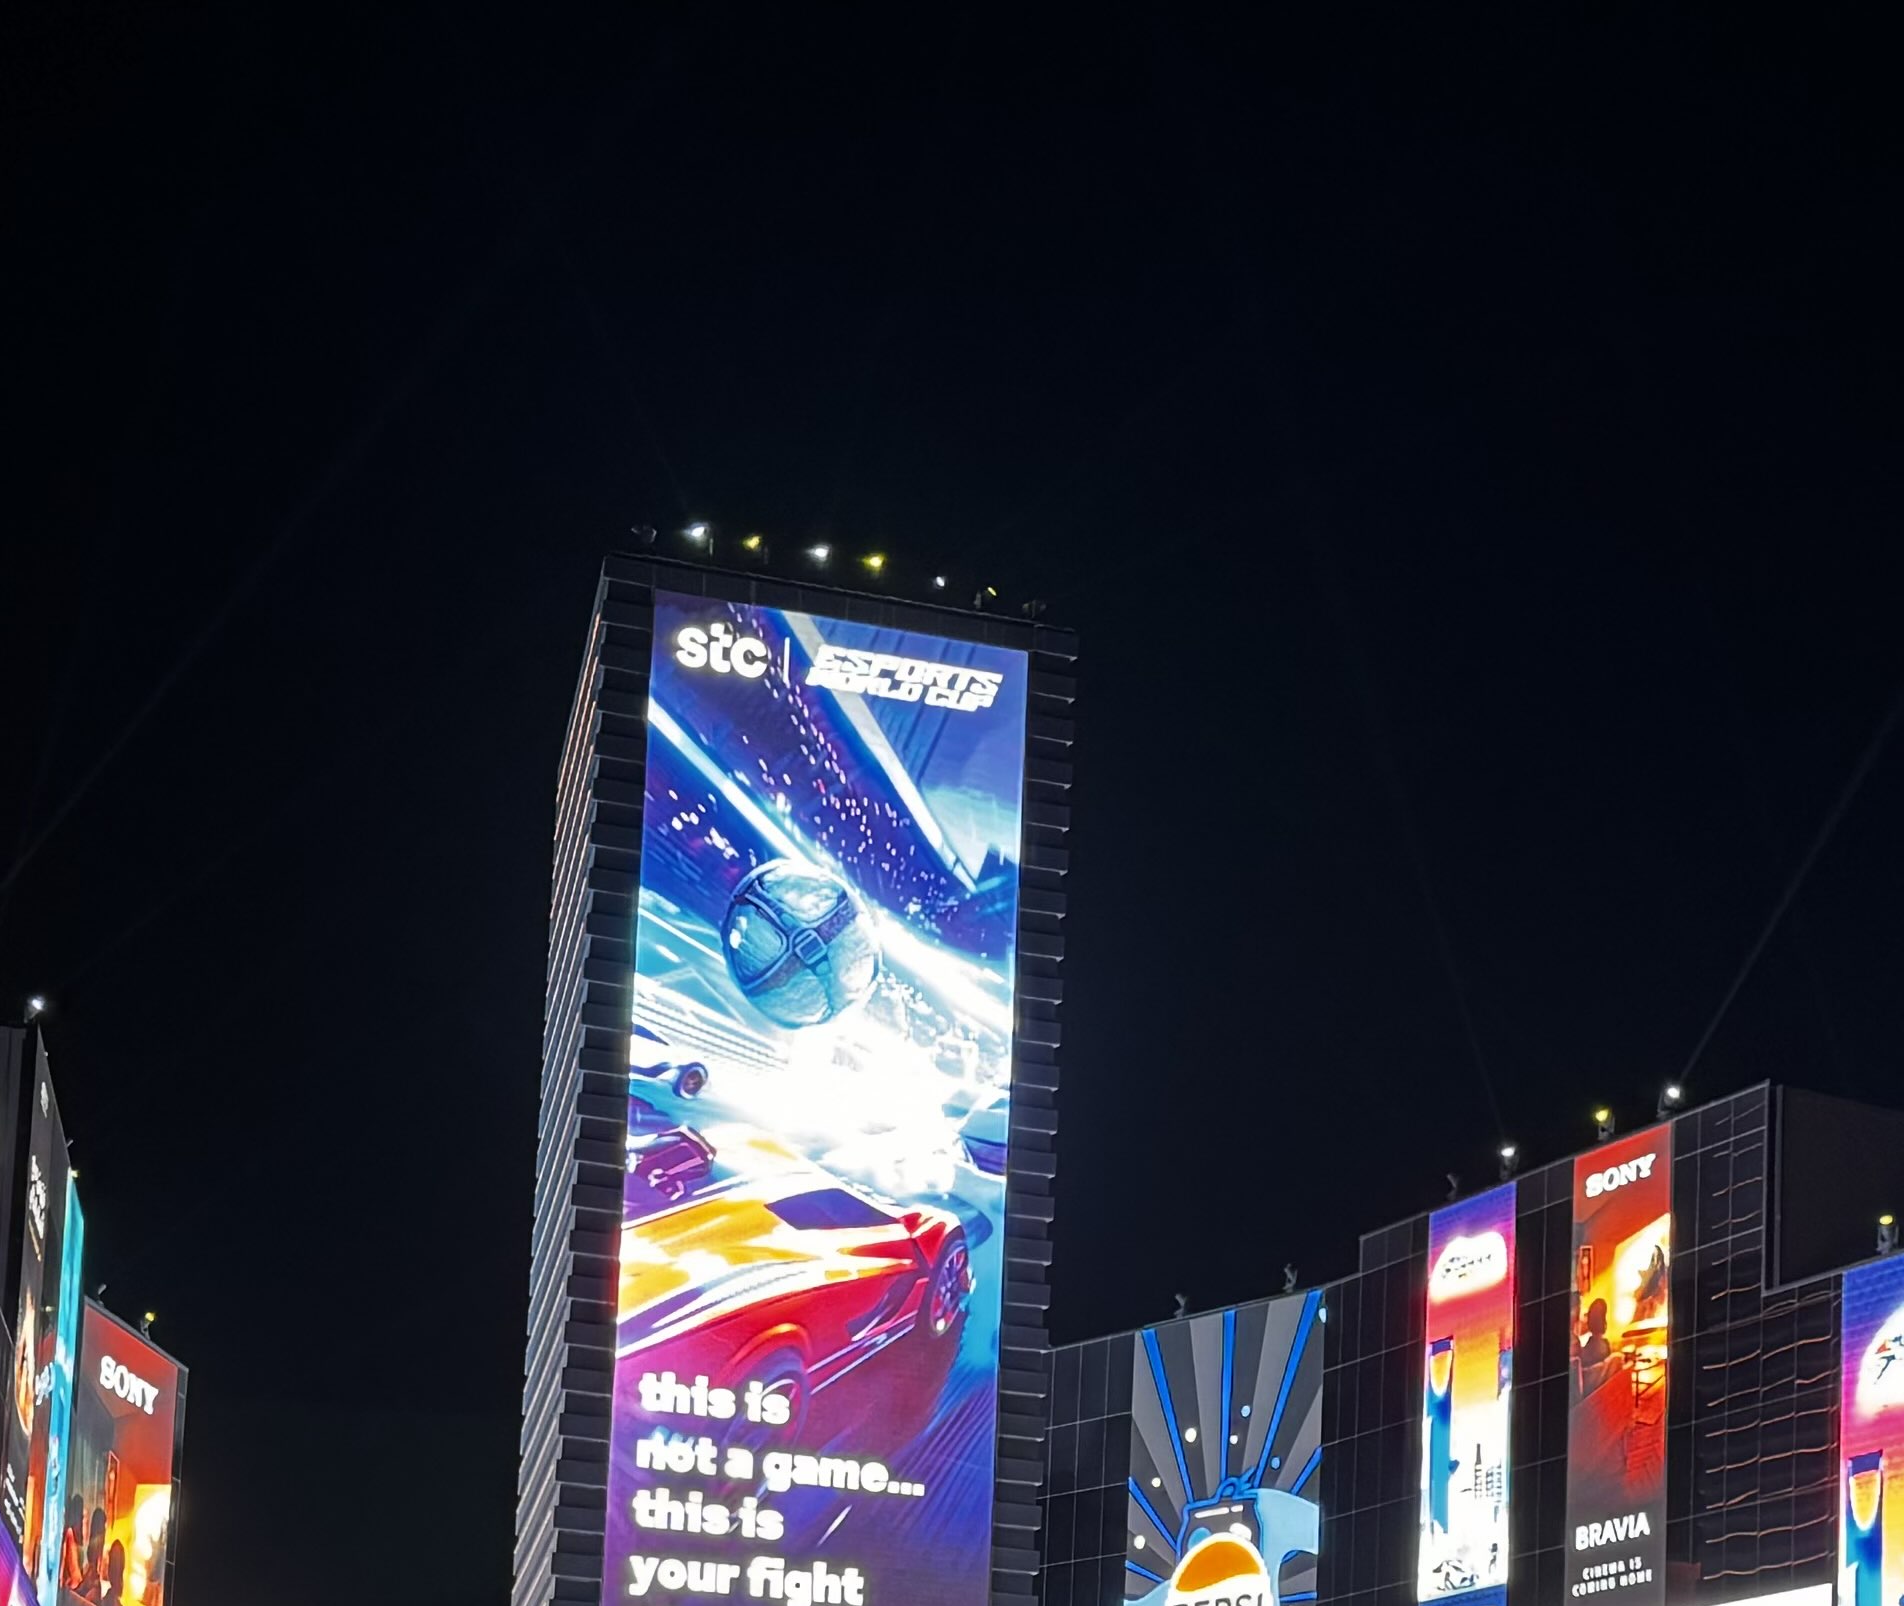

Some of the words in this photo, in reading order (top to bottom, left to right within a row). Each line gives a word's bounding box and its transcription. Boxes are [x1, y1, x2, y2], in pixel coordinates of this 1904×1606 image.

[675, 622, 769, 678] stc
[814, 644, 1003, 693] ESPORTS
[806, 669, 921, 703] WORLD
[925, 684, 995, 712] CUP
[1585, 1152, 1656, 1198] SONY
[99, 1355, 159, 1415] SONY
[638, 1371, 736, 1418] this
[745, 1381, 790, 1425] is
[636, 1436, 717, 1475] not
[725, 1447, 753, 1480] a
[763, 1449, 925, 1497] game...
[633, 1488, 731, 1535] this
[738, 1497, 784, 1540] is
[1575, 1511, 1651, 1553] BRAVIA
[629, 1555, 739, 1596] your
[1571, 1574, 1617, 1597] COMING
[1618, 1568, 1652, 1587] HOME
[1582, 1561, 1626, 1581] CINEMA
[1628, 1556, 1642, 1572] IS
